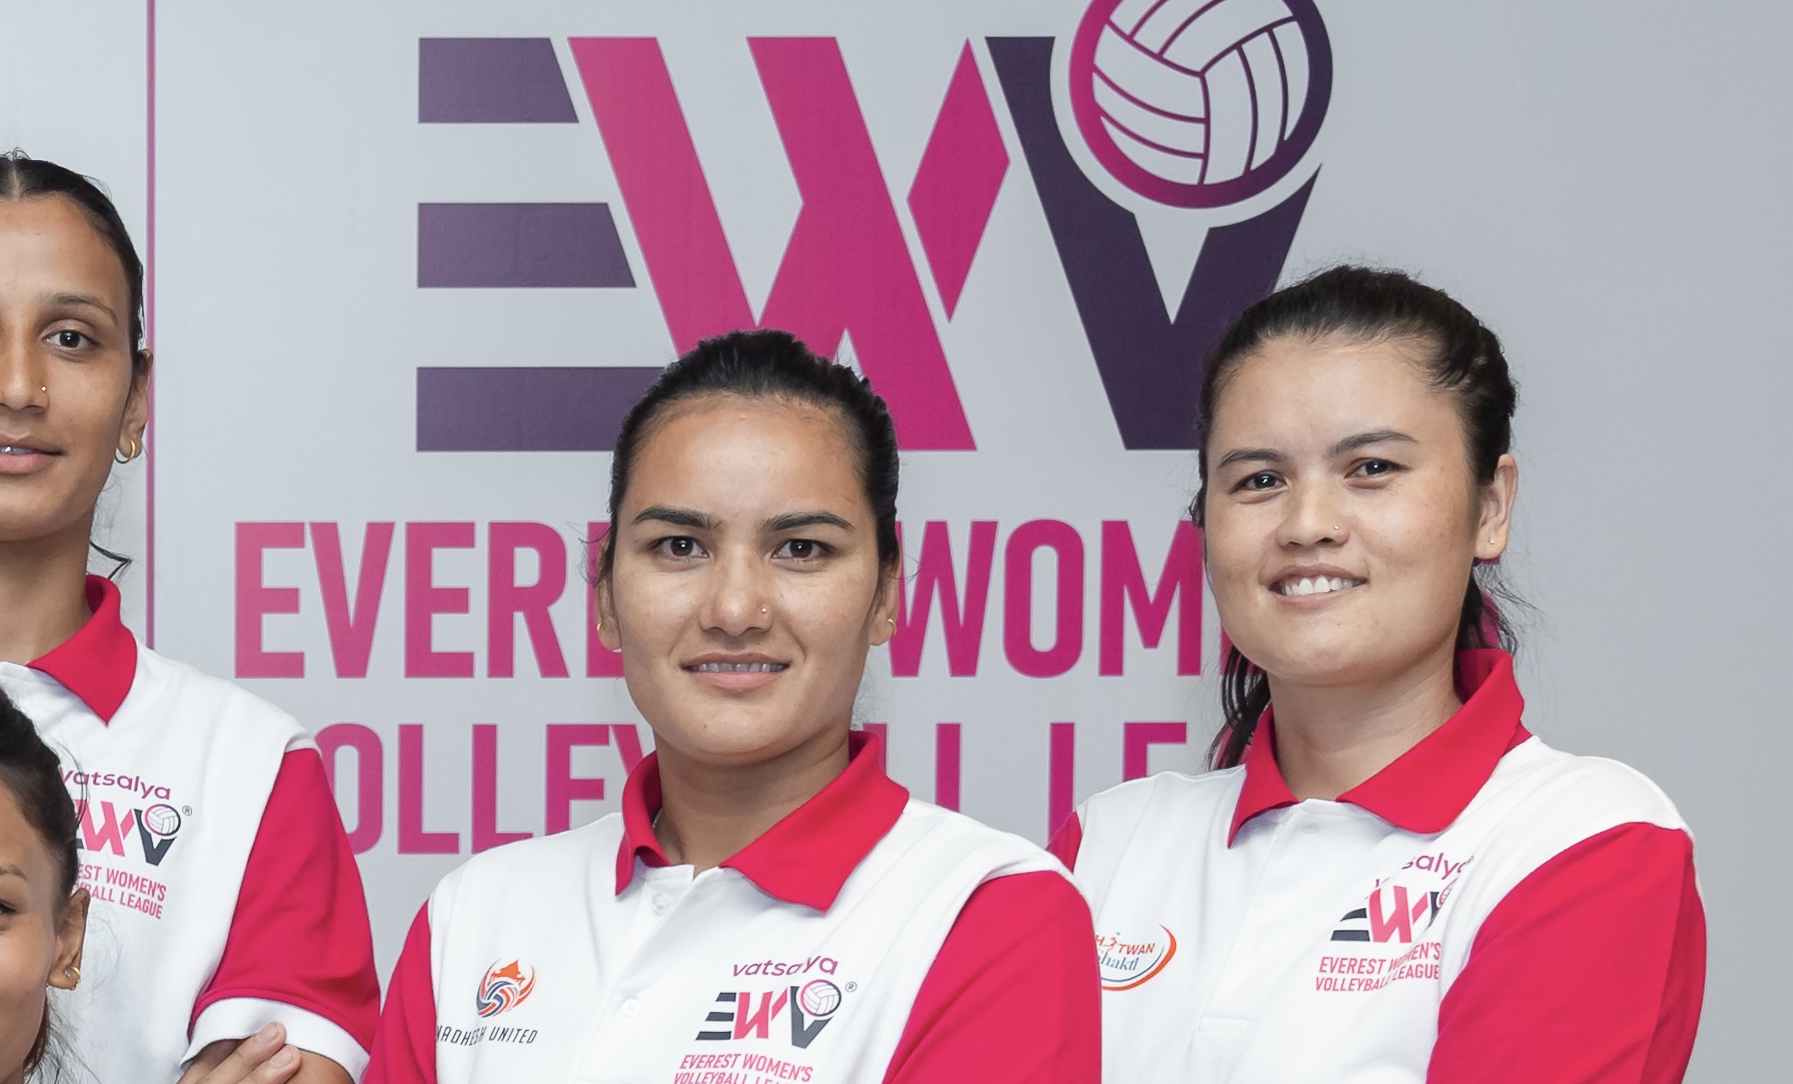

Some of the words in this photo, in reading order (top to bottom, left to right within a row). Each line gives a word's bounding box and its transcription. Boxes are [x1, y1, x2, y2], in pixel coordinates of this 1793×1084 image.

[59, 766, 171, 800] vatsalya
[105, 867, 167, 903] WOMEN'S
[118, 890, 164, 920] LEAGUE
[1318, 955, 1387, 975] EVEREST
[488, 1025, 539, 1045] UNITED
[679, 1052, 742, 1070] EVEREST
[742, 1053, 814, 1083] WOMEN'S
